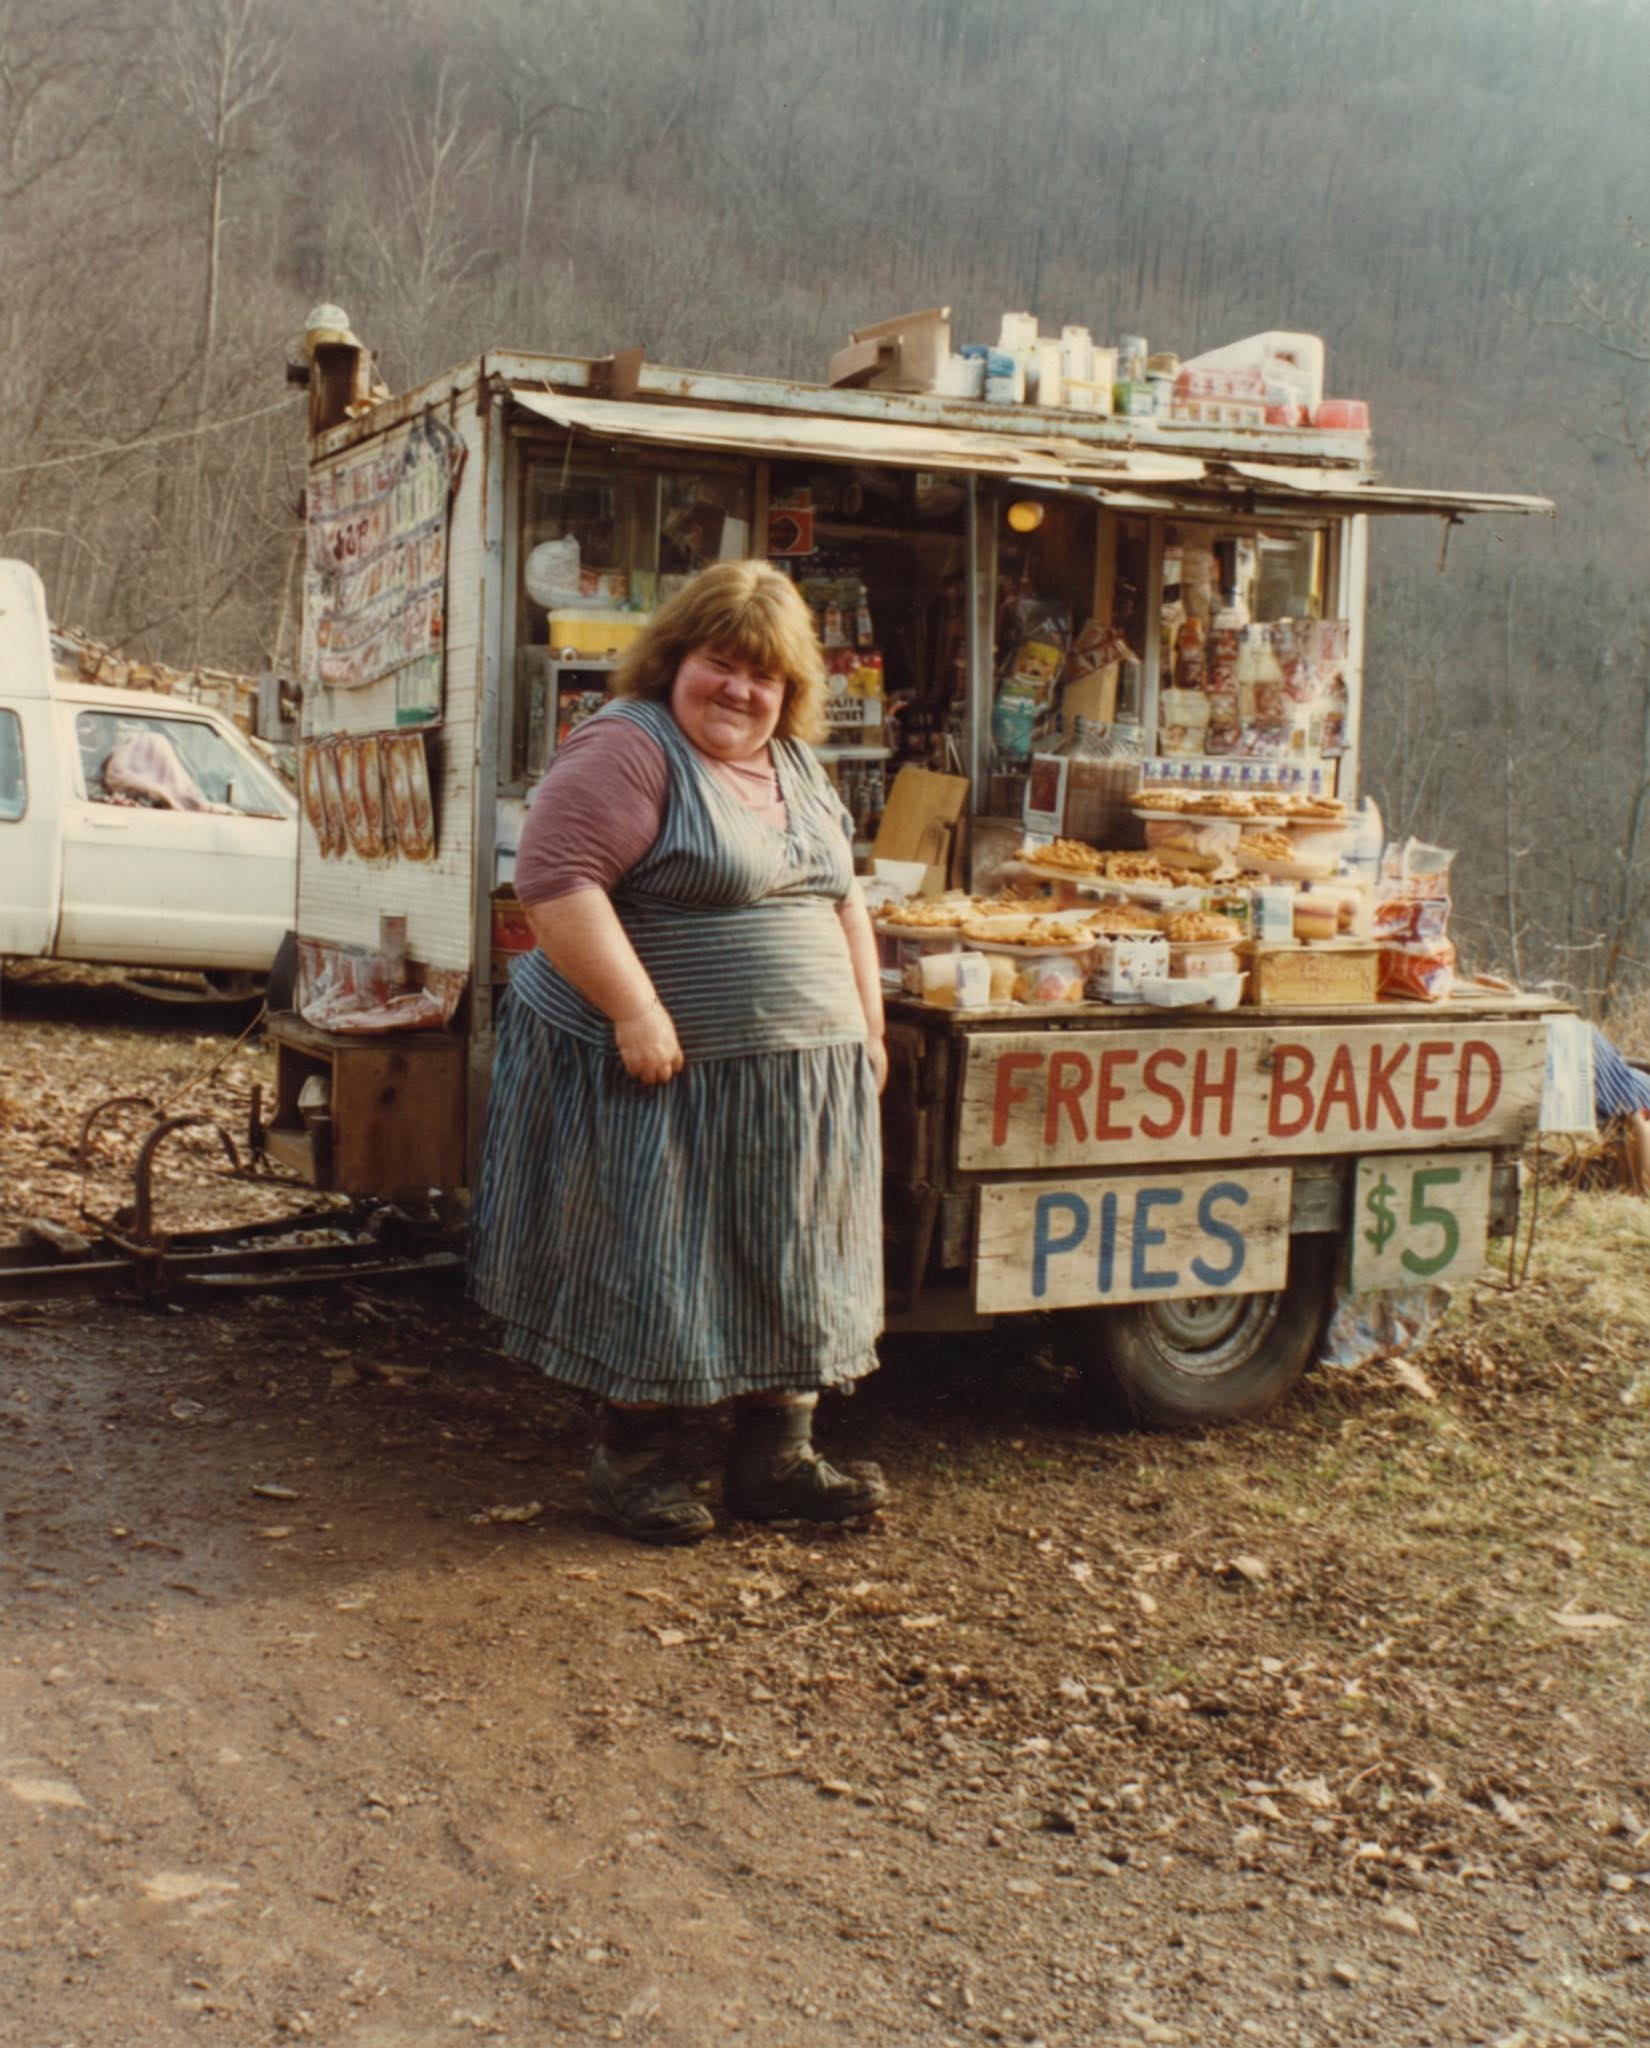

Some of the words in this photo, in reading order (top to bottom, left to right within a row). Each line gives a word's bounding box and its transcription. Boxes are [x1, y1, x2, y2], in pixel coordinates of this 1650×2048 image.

[991, 1048, 1238, 1146] FRESH
[1267, 1040, 1502, 1138] BAKED
[1031, 1181, 1249, 1298] PIES
[1364, 1167, 1462, 1276] $5
